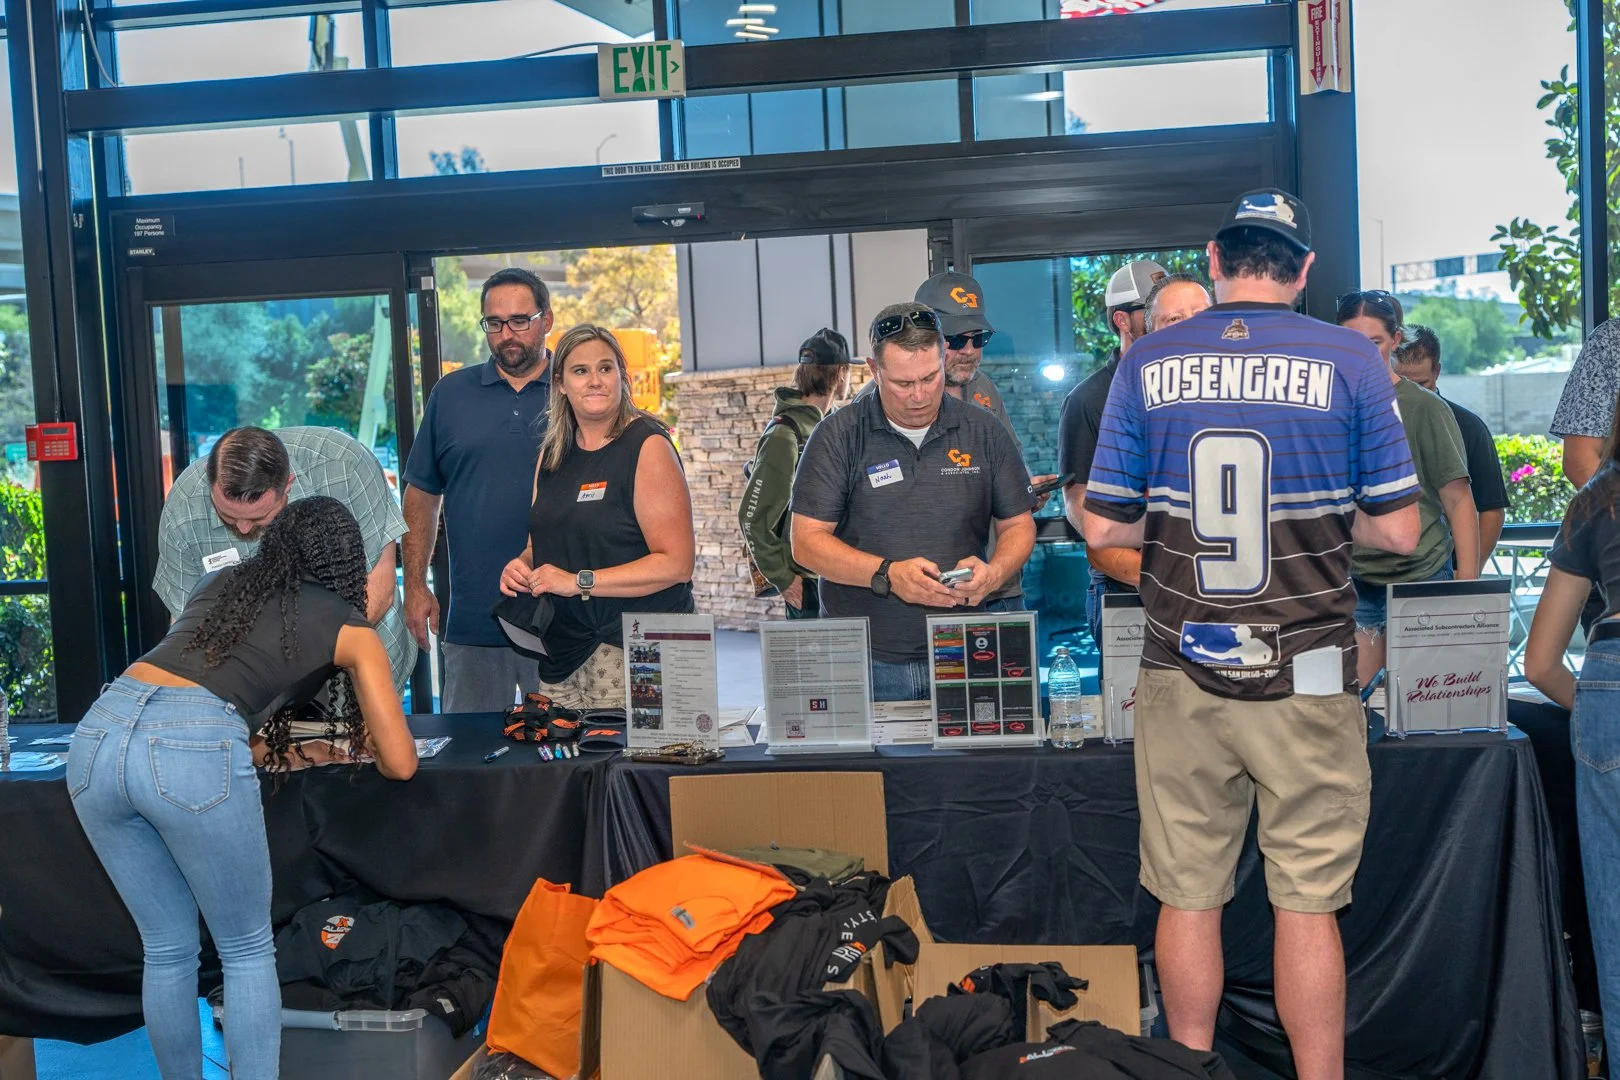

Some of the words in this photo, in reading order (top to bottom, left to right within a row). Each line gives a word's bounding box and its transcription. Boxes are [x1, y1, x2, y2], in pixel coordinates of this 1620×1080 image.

[1310, 6, 1323, 20] FIRE
[1314, 20, 1322, 83] EXTINGUISHER
[613, 45, 672, 94] EXIT
[603, 166, 614, 176] THIS
[614, 166, 626, 175] DOOR
[627, 165, 634, 174] TO
[634, 164, 652, 174] REMAIN
[653, 163, 676, 172] UNLOCKED
[676, 162, 690, 171] WHEN
[690, 160, 711, 170] BUILDING
[718, 159, 739, 168] OCCUPIED
[1142, 354, 1333, 410] ROSENGREN
[746, 479, 763, 518] UNITED
[1190, 430, 1271, 597] 9
[1228, 670, 1240, 678] SAN
[1241, 670, 1259, 678] DIEGO
[1415, 674, 1439, 689] We
[1444, 671, 1482, 687] Build
[1406, 685, 1491, 704] Relationships
